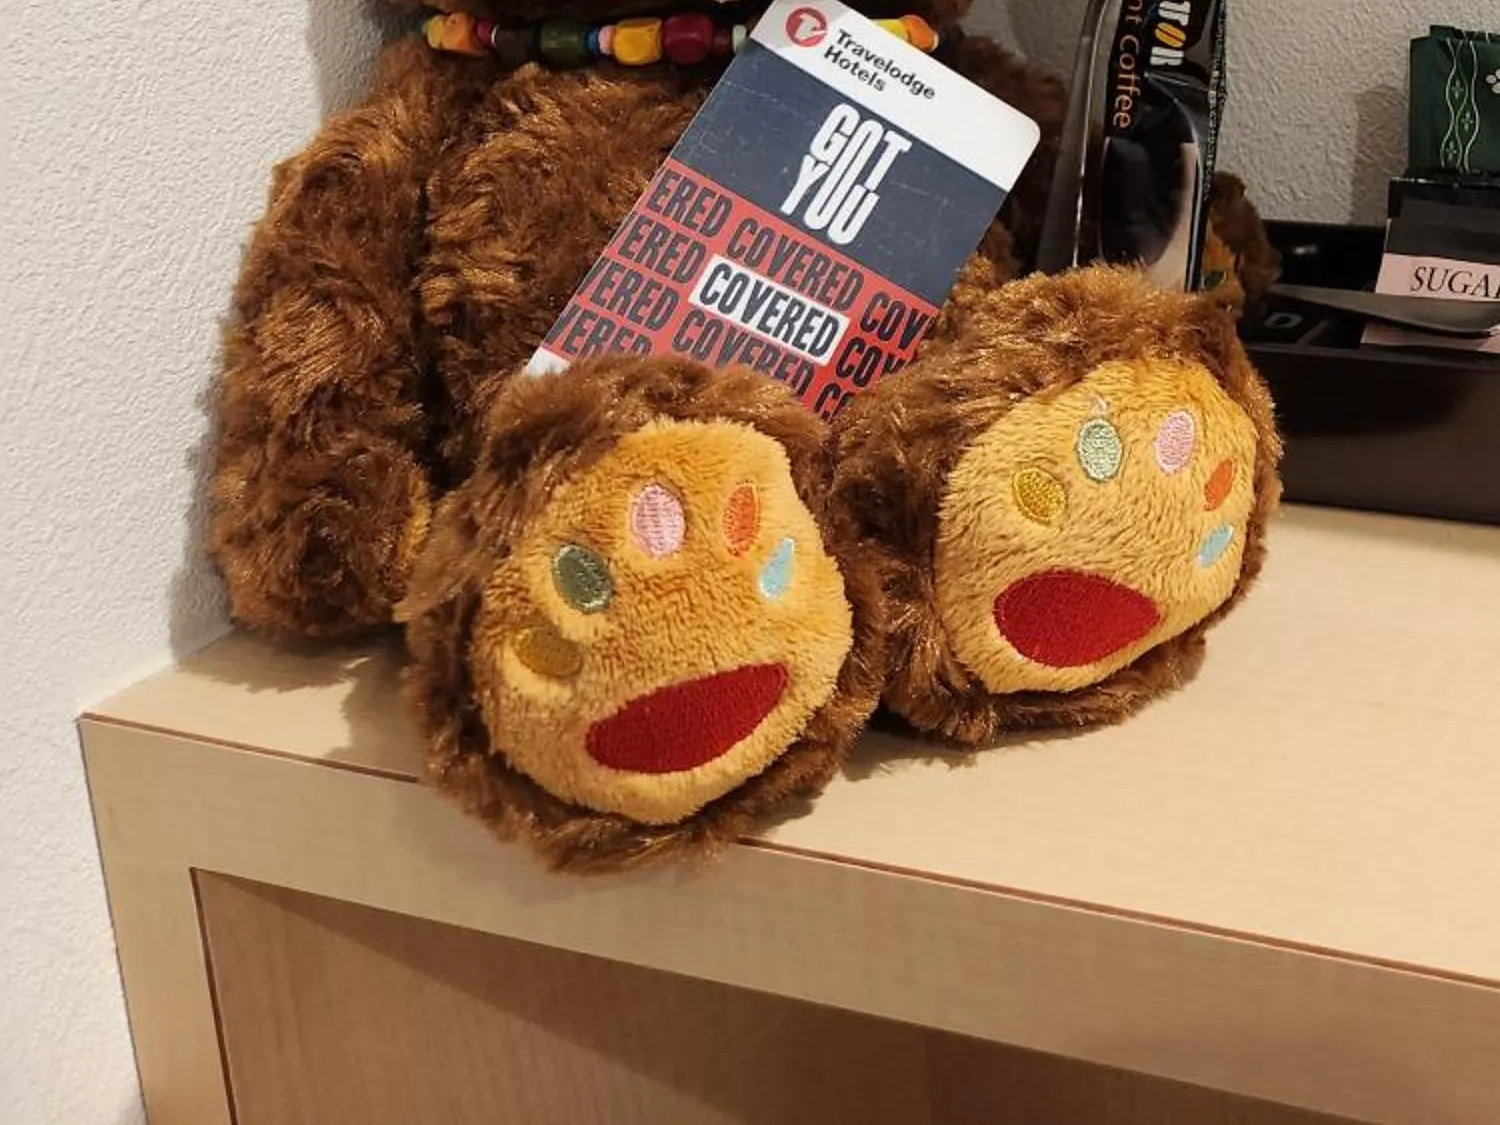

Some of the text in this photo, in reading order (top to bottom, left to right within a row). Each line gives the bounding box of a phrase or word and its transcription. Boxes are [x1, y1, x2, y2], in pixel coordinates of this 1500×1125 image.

[823, 46, 887, 92] Hotels
[837, 29, 935, 100] Travelodge
[1112, 34, 1141, 129] Coffee
[810, 103, 912, 192] GOT
[780, 155, 880, 244] YOU
[699, 262, 839, 358] COVERED
[727, 218, 865, 311] COVERED
[860, 290, 937, 350] COV
